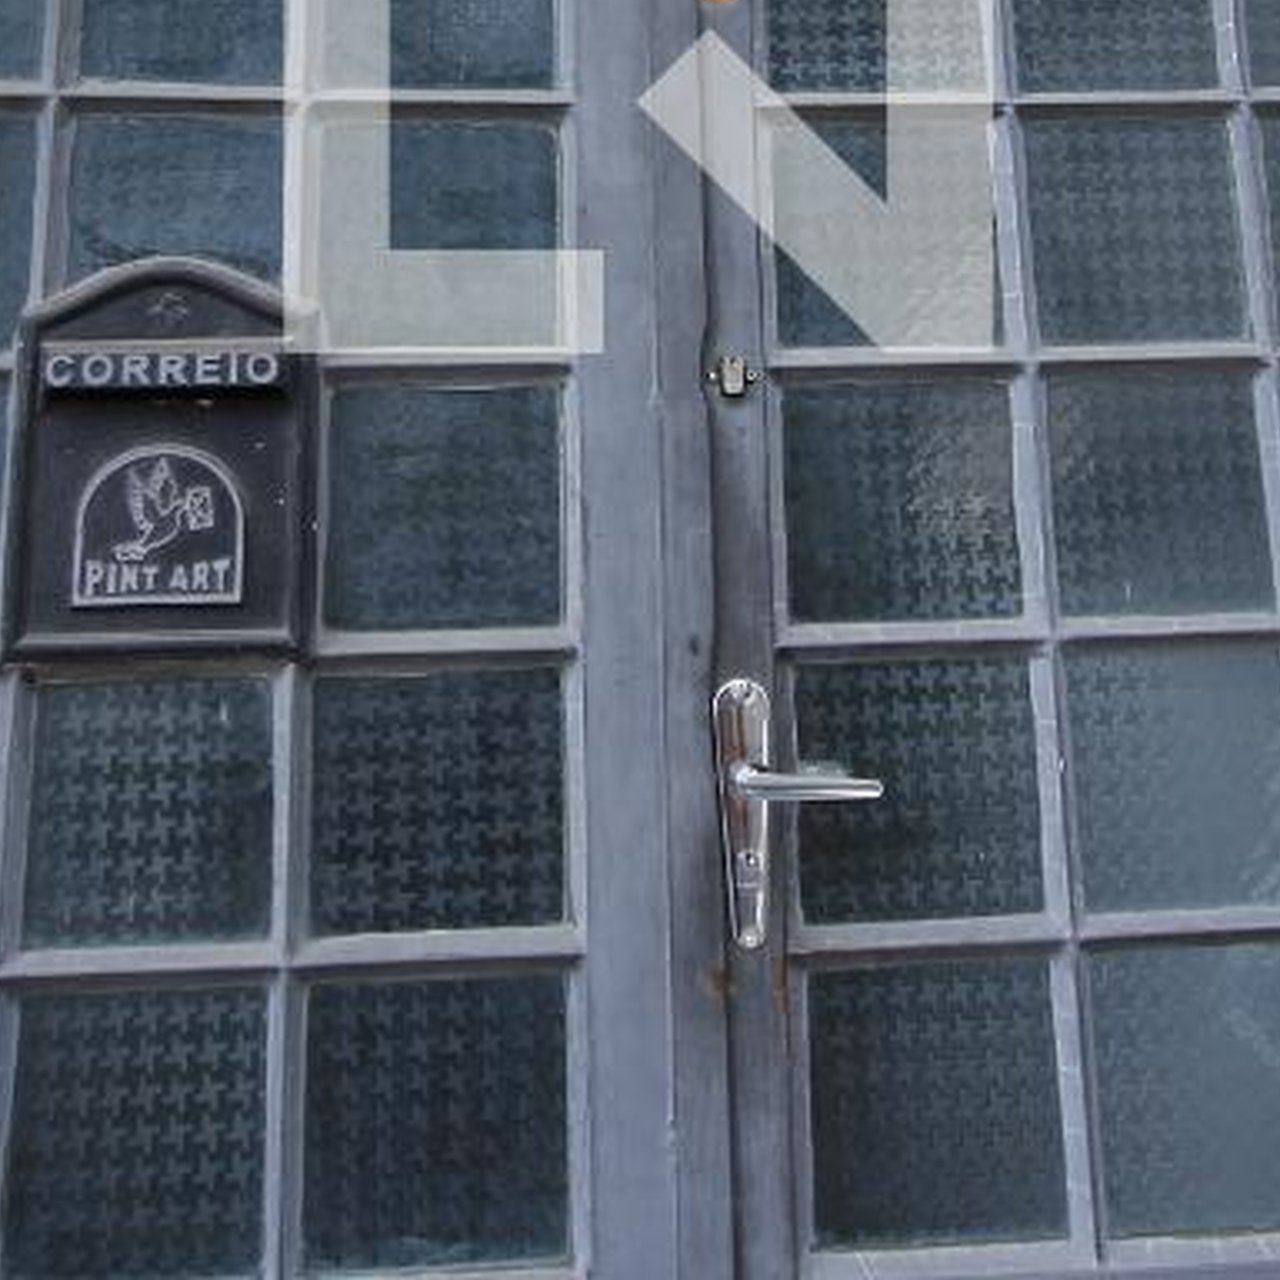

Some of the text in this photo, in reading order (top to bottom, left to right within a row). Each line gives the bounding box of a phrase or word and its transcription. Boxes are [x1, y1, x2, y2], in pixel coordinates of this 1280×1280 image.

[45, 351, 280, 387] CORREIO
[85, 557, 231, 595] PINT ART
